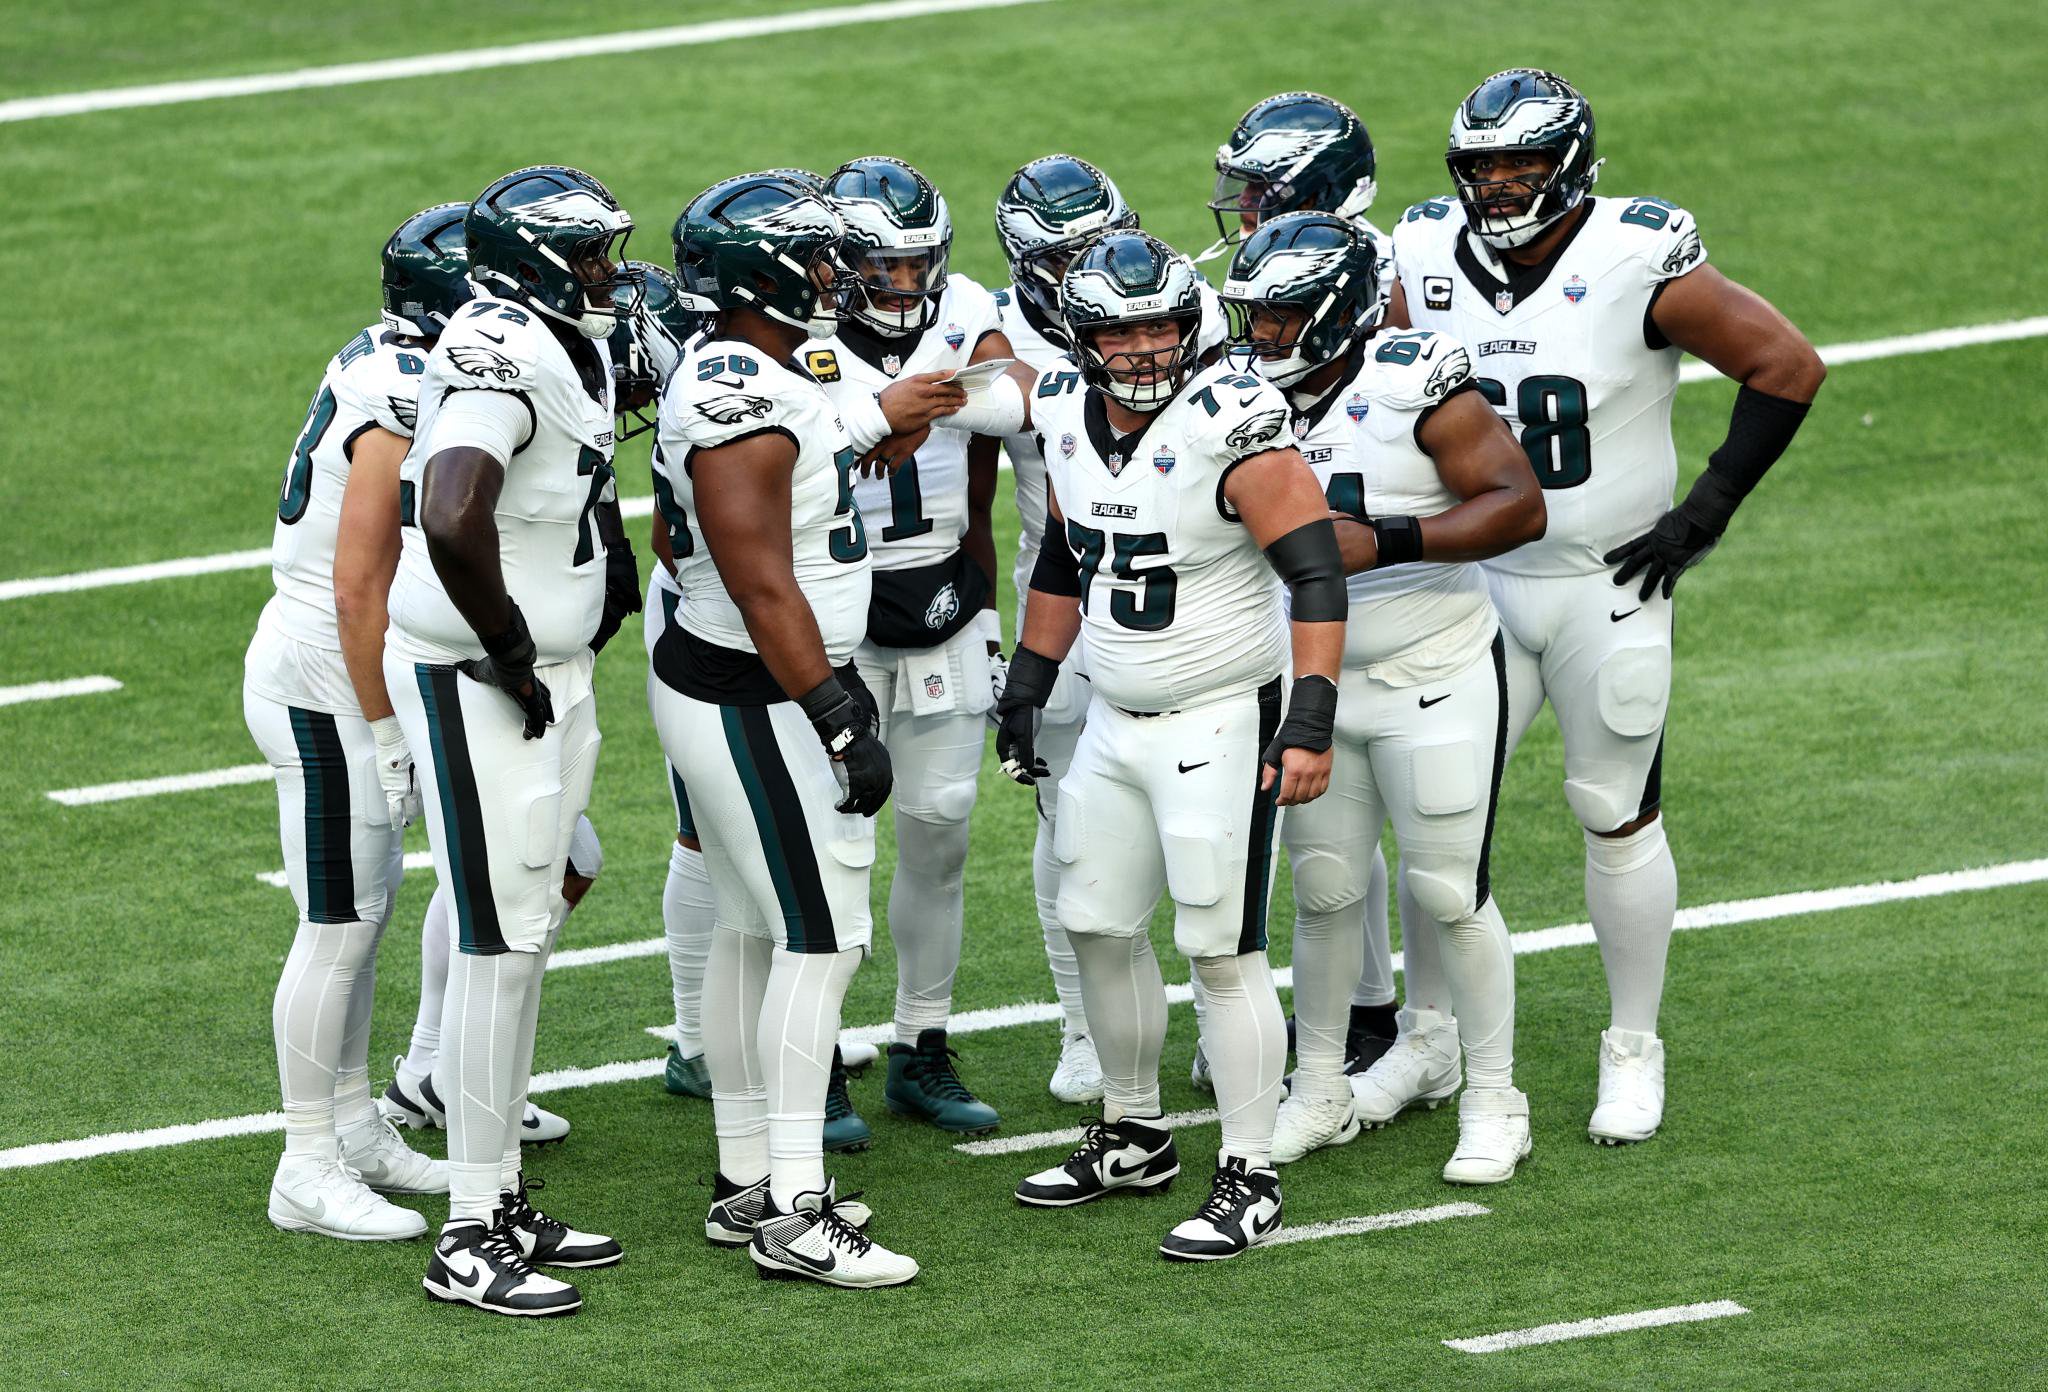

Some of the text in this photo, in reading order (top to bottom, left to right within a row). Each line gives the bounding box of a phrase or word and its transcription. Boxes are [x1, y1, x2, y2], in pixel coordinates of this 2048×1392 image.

[1425, 278, 1452, 302] C
[465, 302, 530, 327] 72
[1127, 301, 1162, 312] EAGLES
[1478, 340, 1537, 357] EAGLES
[808, 351, 837, 376] C
[1187, 374, 1261, 418] 75
[882, 454, 934, 543] 1
[1092, 502, 1137, 519] EAGLES
[1067, 517, 1178, 631] 75
